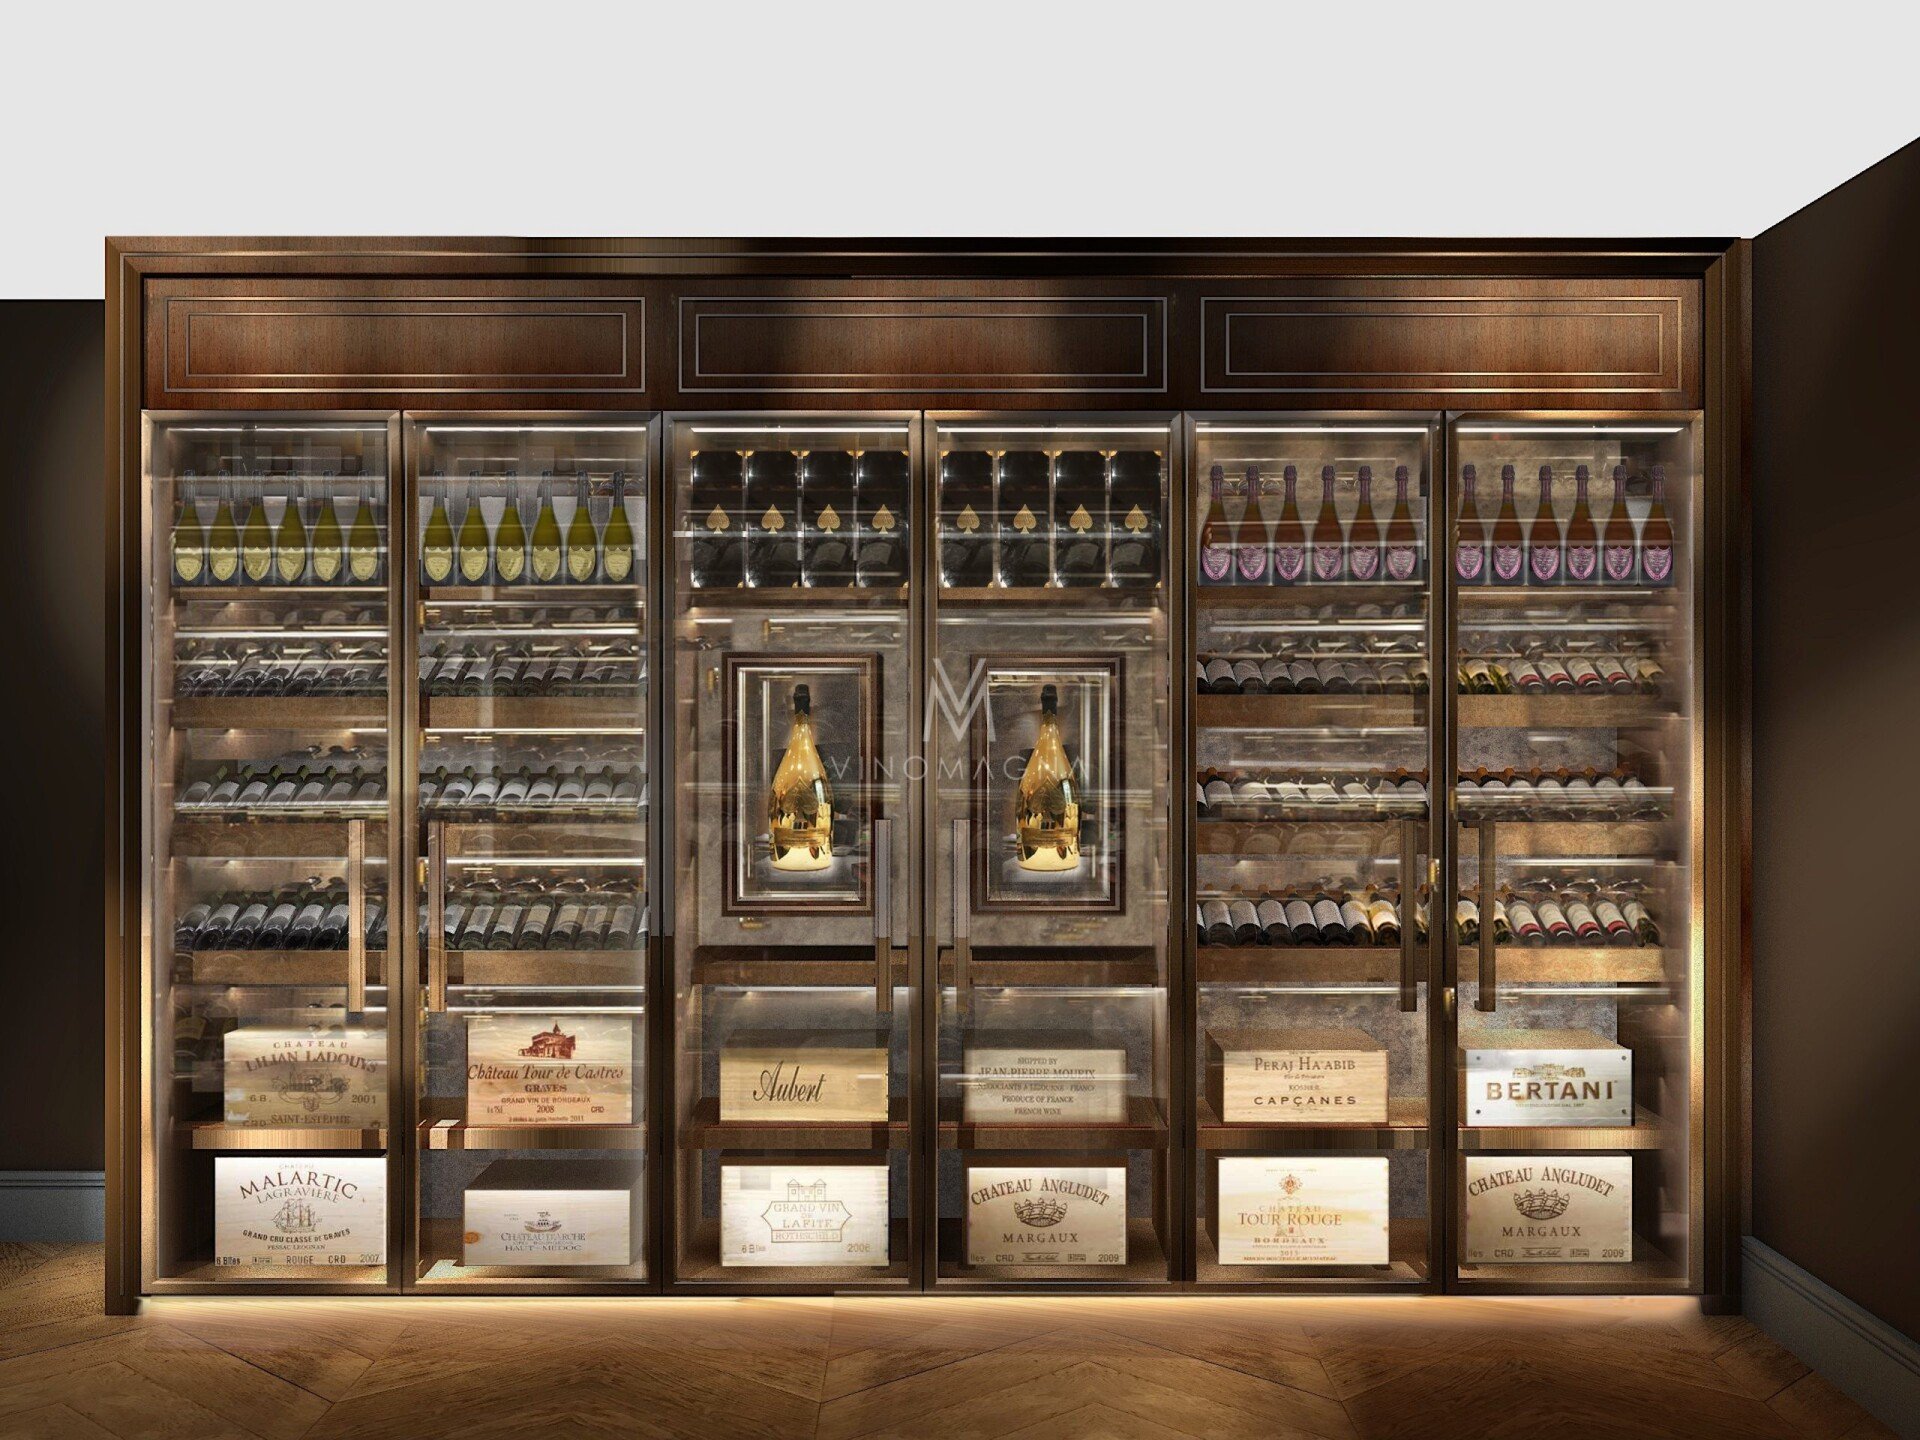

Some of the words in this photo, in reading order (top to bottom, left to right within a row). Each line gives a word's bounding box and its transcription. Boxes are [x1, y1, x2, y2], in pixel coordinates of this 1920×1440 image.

[273, 1040, 348, 1048] CHATEAU
[245, 1051, 298, 1072] LILIAN
[306, 1050, 377, 1073] LADOUYS
[468, 1064, 519, 1079] Château
[523, 1064, 553, 1079] Tour
[557, 1064, 570, 1079] de
[574, 1063, 624, 1079] Castres
[753, 1060, 826, 1102] Aubert
[525, 1084, 567, 1093] GRAVES
[1486, 1081, 1614, 1100] BERTANI
[352, 1095, 376, 1103] 2001
[1254, 1096, 1356, 1107] CAPÇANES
[240, 1171, 358, 1199] MALARTIC
[1468, 1167, 1532, 1196] CHATEAU
[1541, 1166, 1614, 1197] ANGLUDET
[971, 1178, 1032, 1205] CHATEAU
[1040, 1177, 1110, 1206] ANGLUDET
[783, 1219, 832, 1228] LAFITE
[1238, 1212, 1280, 1226] TOUR
[1288, 1212, 1342, 1226] ROUGE
[242, 1229, 268, 1241] GRAND
[270, 1235, 284, 1243] CRU
[286, 1235, 311, 1243] CLASSE
[323, 1228, 351, 1241] GRAVES
[1502, 1227, 1581, 1237] MARGAUX
[1002, 1233, 1078, 1243] MARGAUX
[1098, 1253, 1119, 1262] 2009
[1602, 1249, 1624, 1258] 2009
[286, 1255, 314, 1264] ROUGE
